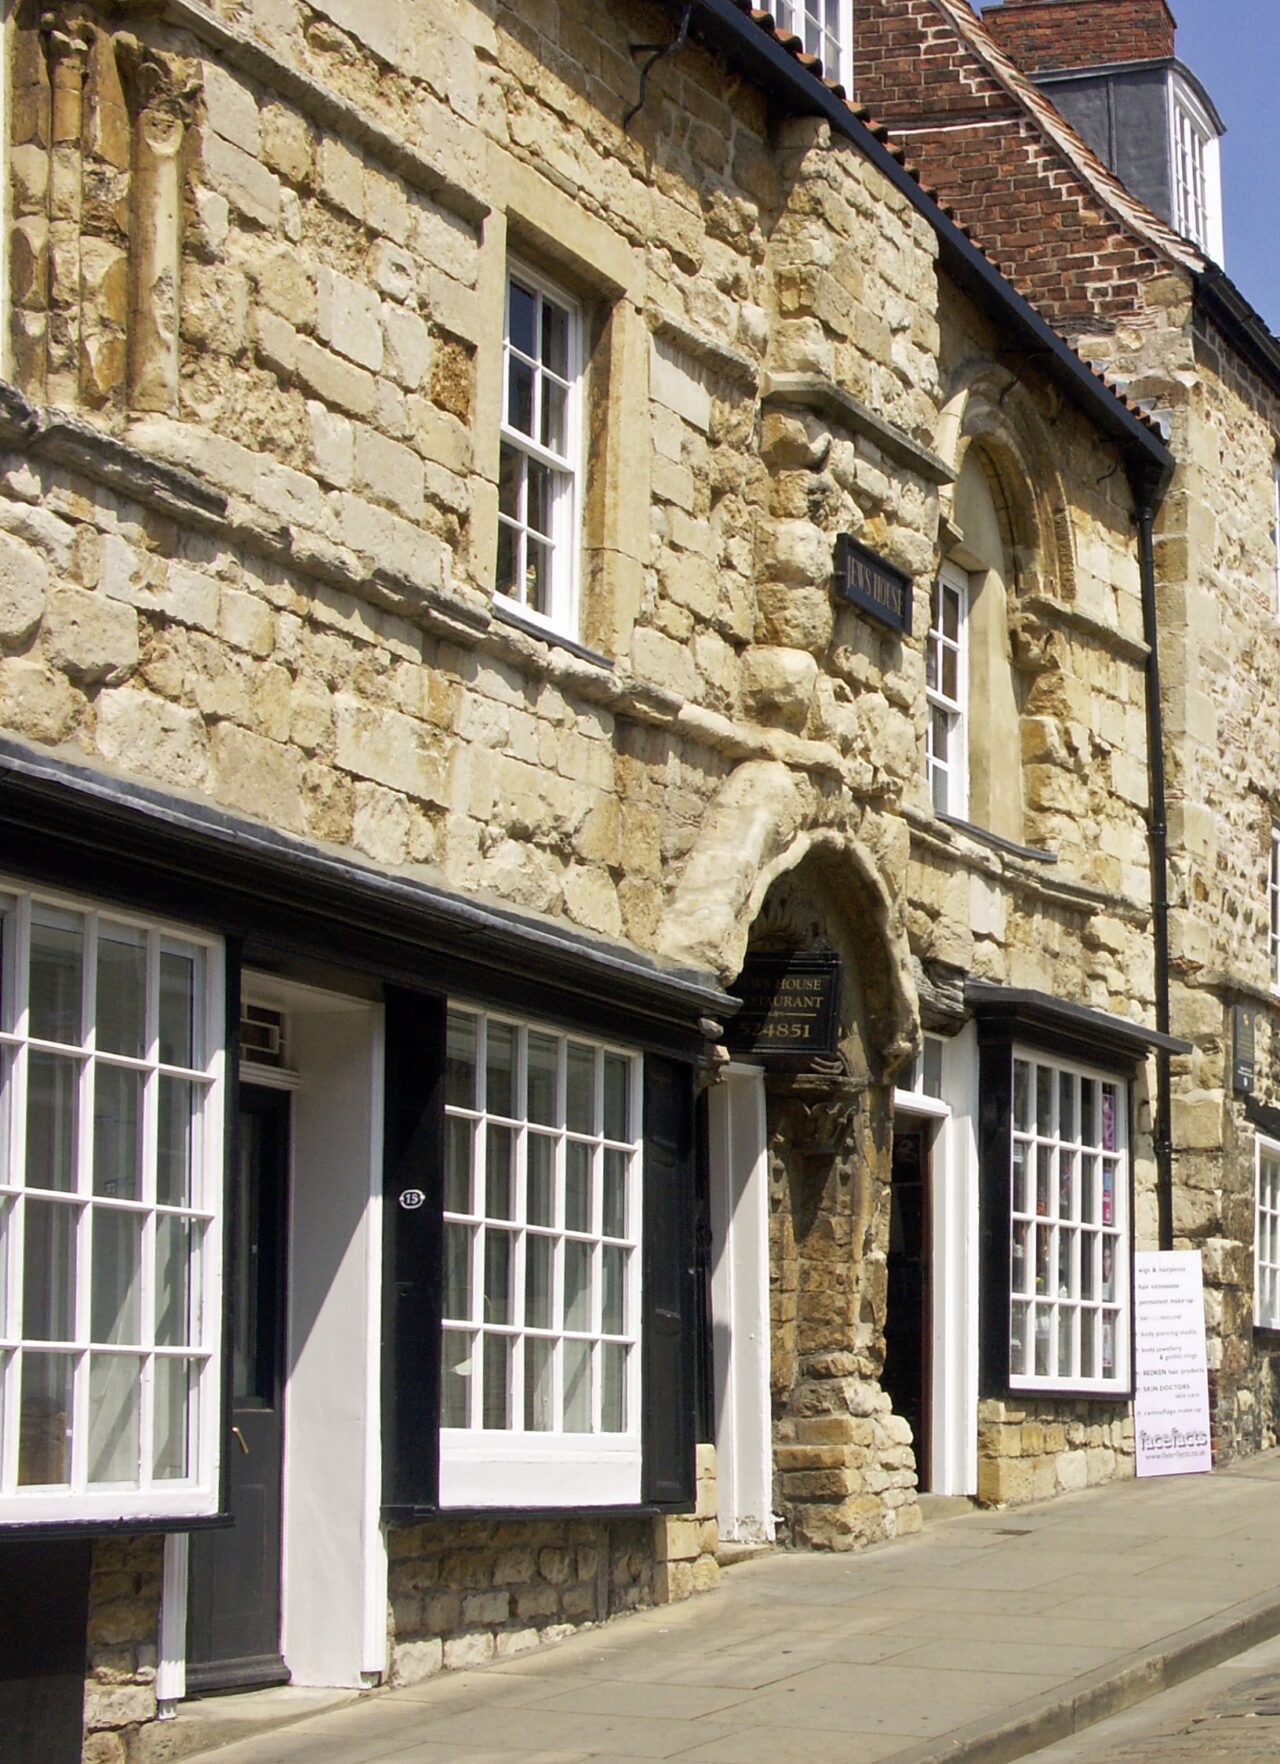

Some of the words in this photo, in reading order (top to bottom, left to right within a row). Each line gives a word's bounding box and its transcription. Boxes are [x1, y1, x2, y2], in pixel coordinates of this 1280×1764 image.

[873, 572, 903, 617] HOUSE
[776, 978, 822, 992] HOUSE
[739, 1022, 811, 1040] 524851
[405, 1193, 419, 1205] 15
[1143, 1368, 1167, 1376] REDKEN
